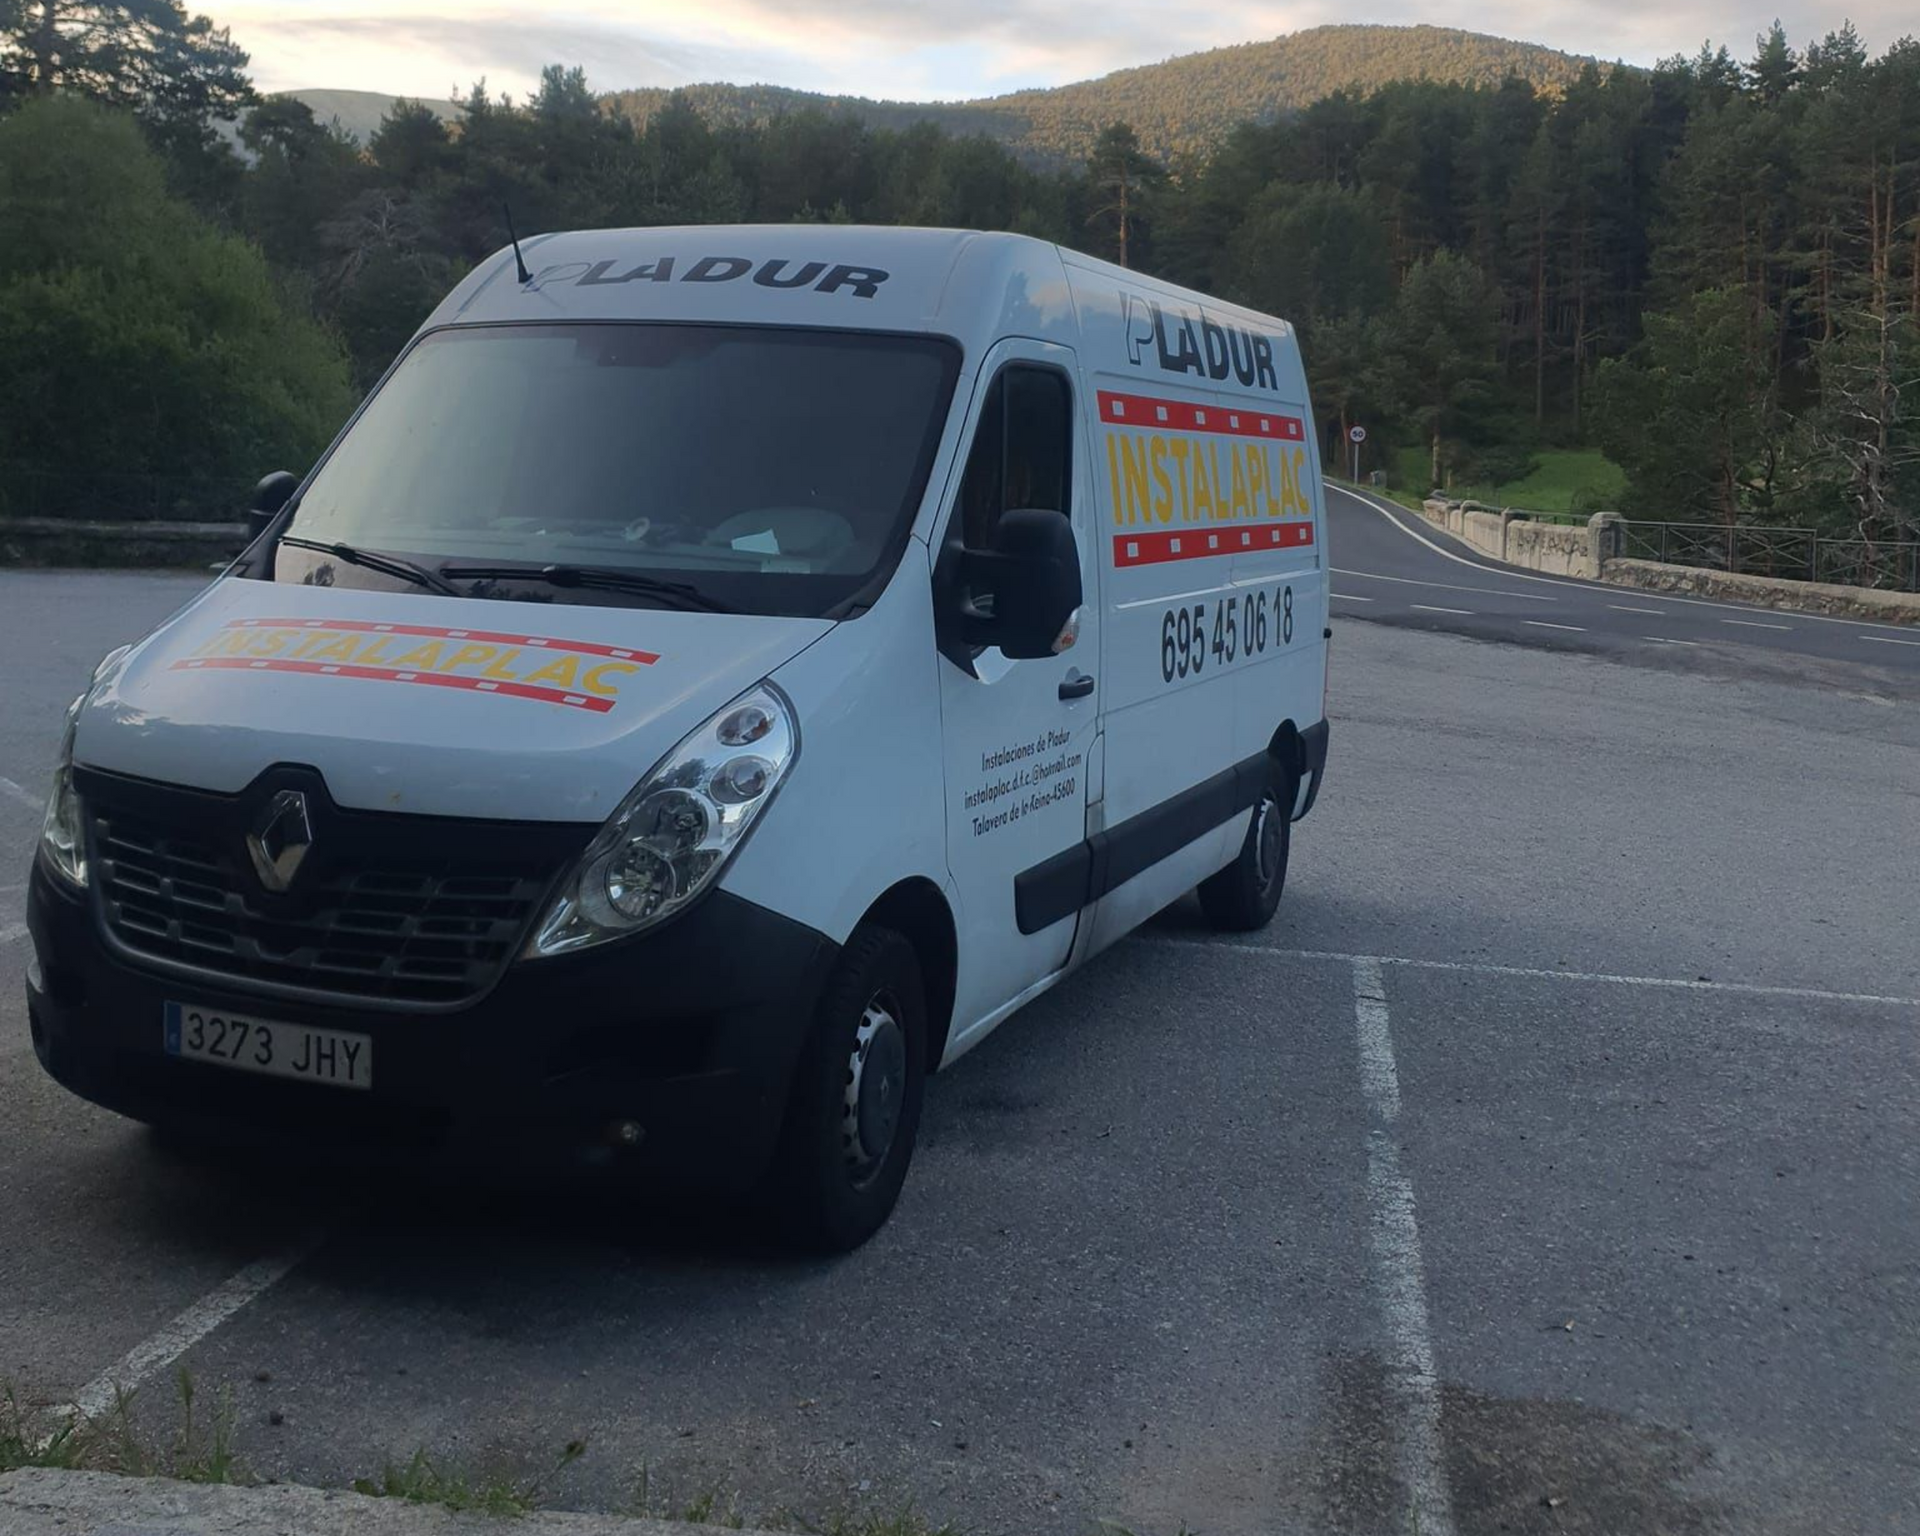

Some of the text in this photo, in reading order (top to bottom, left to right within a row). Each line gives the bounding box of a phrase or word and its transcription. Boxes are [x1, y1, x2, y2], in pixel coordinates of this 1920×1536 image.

[521, 257, 889, 299] PLADUR
[1119, 291, 1278, 391] PLADUR
[1107, 432, 1310, 526] INSTALAPLAC
[192, 629, 641, 695] INSTALAPLAC
[1161, 586, 1293, 683] 695 45 06 18
[981, 727, 1071, 772] Instalaciones de Pladur
[972, 811, 1008, 837] Talavera
[1009, 802, 1020, 822] de
[1021, 799, 1029, 817] la
[187, 1012, 361, 1080] 3273 JHY
